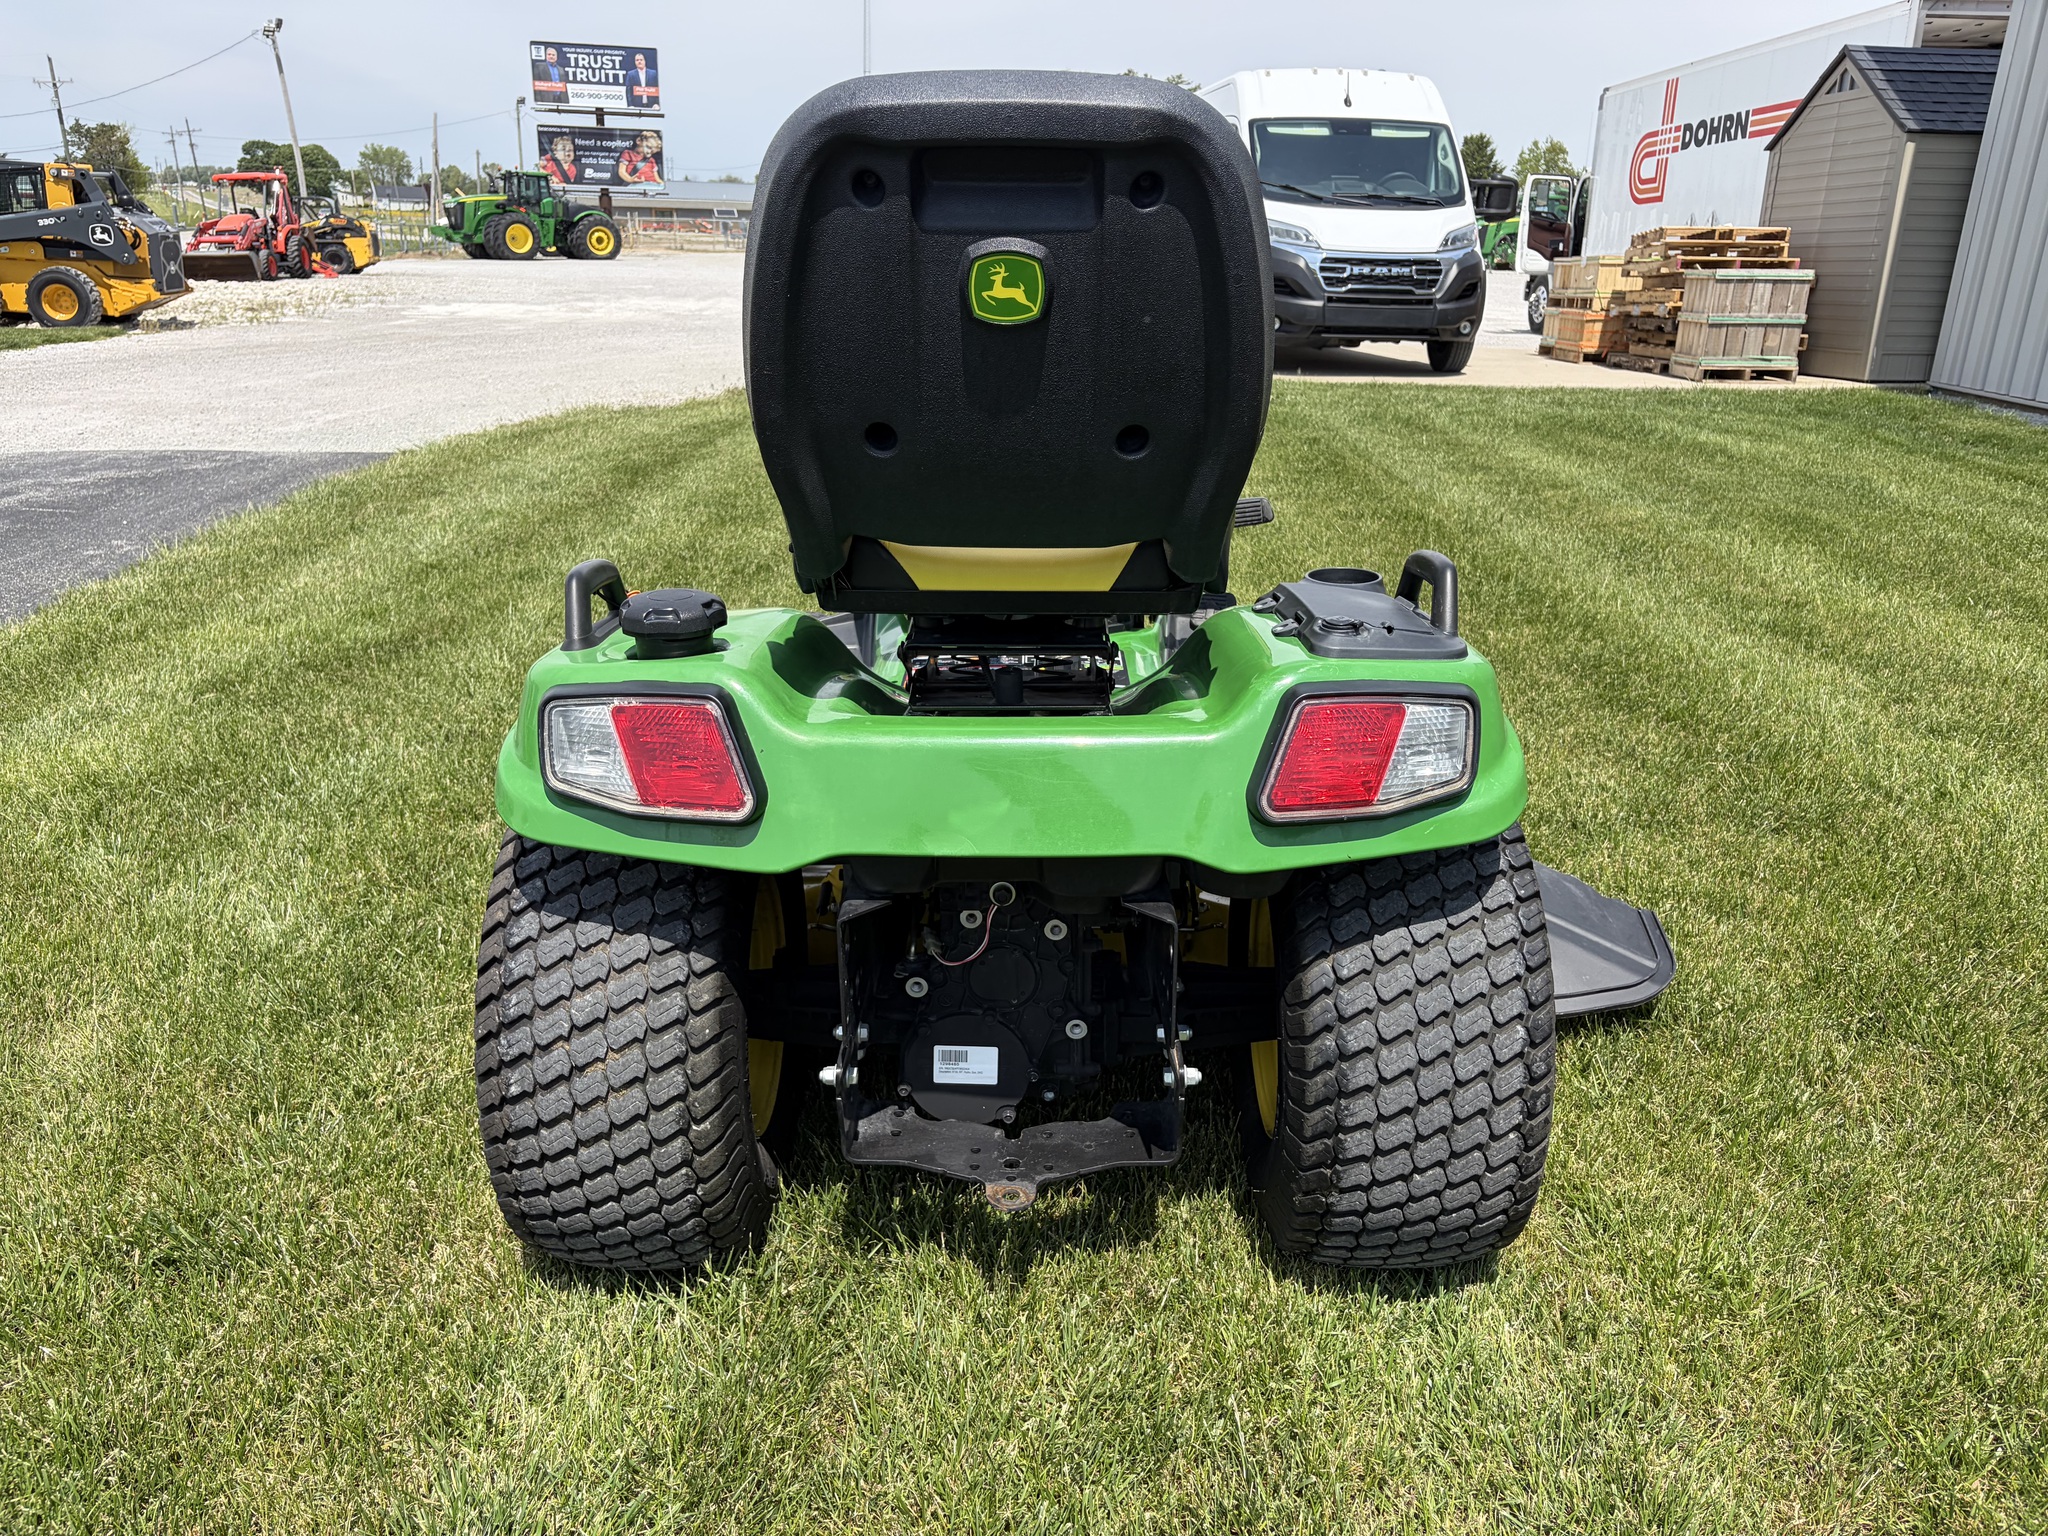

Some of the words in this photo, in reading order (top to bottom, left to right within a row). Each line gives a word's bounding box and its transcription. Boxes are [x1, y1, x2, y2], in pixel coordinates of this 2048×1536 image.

[566, 54, 622, 69] TRUST
[565, 67, 626, 83] TRUITT
[571, 92, 623, 100] 260-900-9000
[1680, 110, 1750, 150] DOHRN
[575, 138, 594, 146] Need
[602, 139, 633, 148] copilot?
[1353, 266, 1410, 276] RAM
